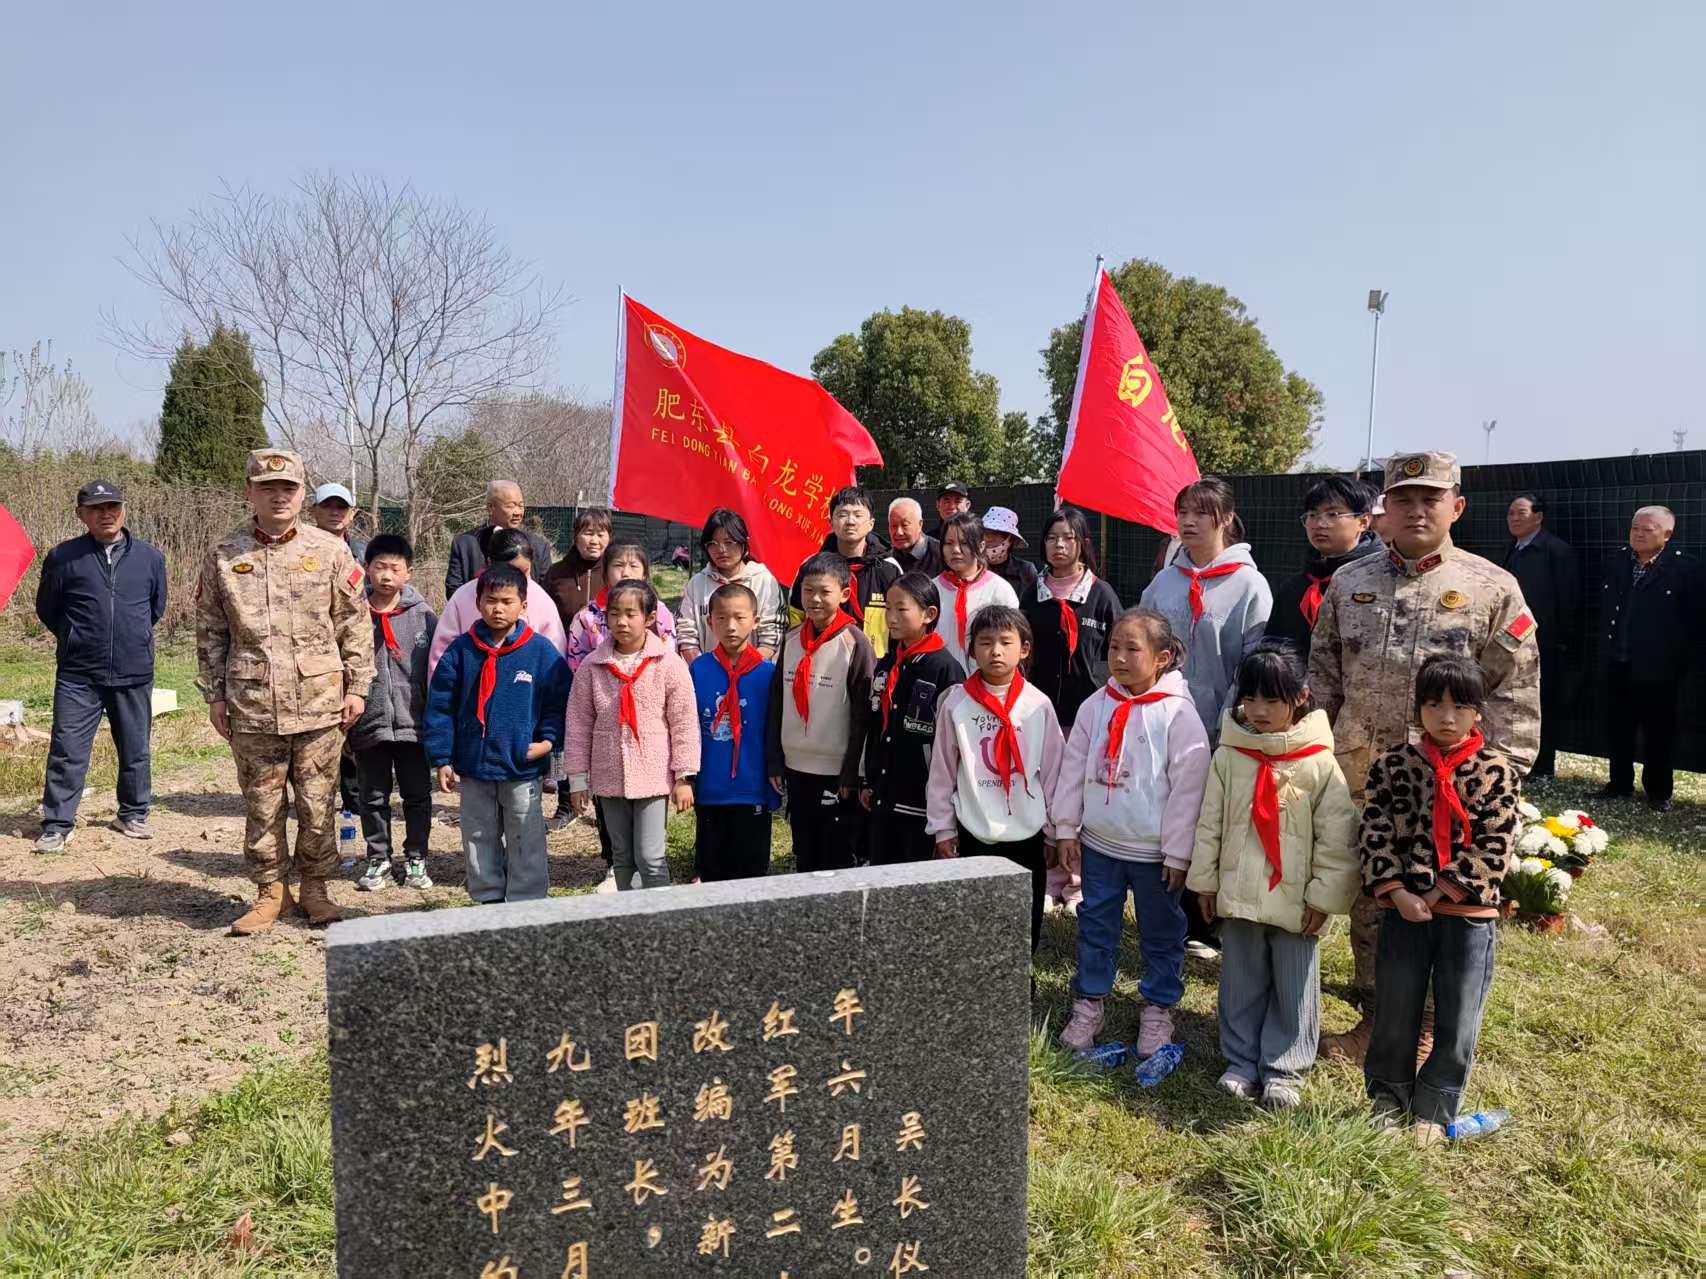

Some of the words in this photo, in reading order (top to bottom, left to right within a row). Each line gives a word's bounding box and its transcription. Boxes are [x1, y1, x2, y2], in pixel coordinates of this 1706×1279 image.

[651, 428, 675, 444] FEI
[682, 436, 711, 457] DONG
[764, 493, 793, 520] ONG
[546, 1028, 593, 1279] 九年三月
[622, 1020, 668, 1248] 团班长，
[692, 1010, 736, 1257] 改编为新
[763, 1000, 800, 1279] 红军第二
[827, 988, 871, 1264] 年六月生。
[889, 1111, 930, 1279] 吴长仪
